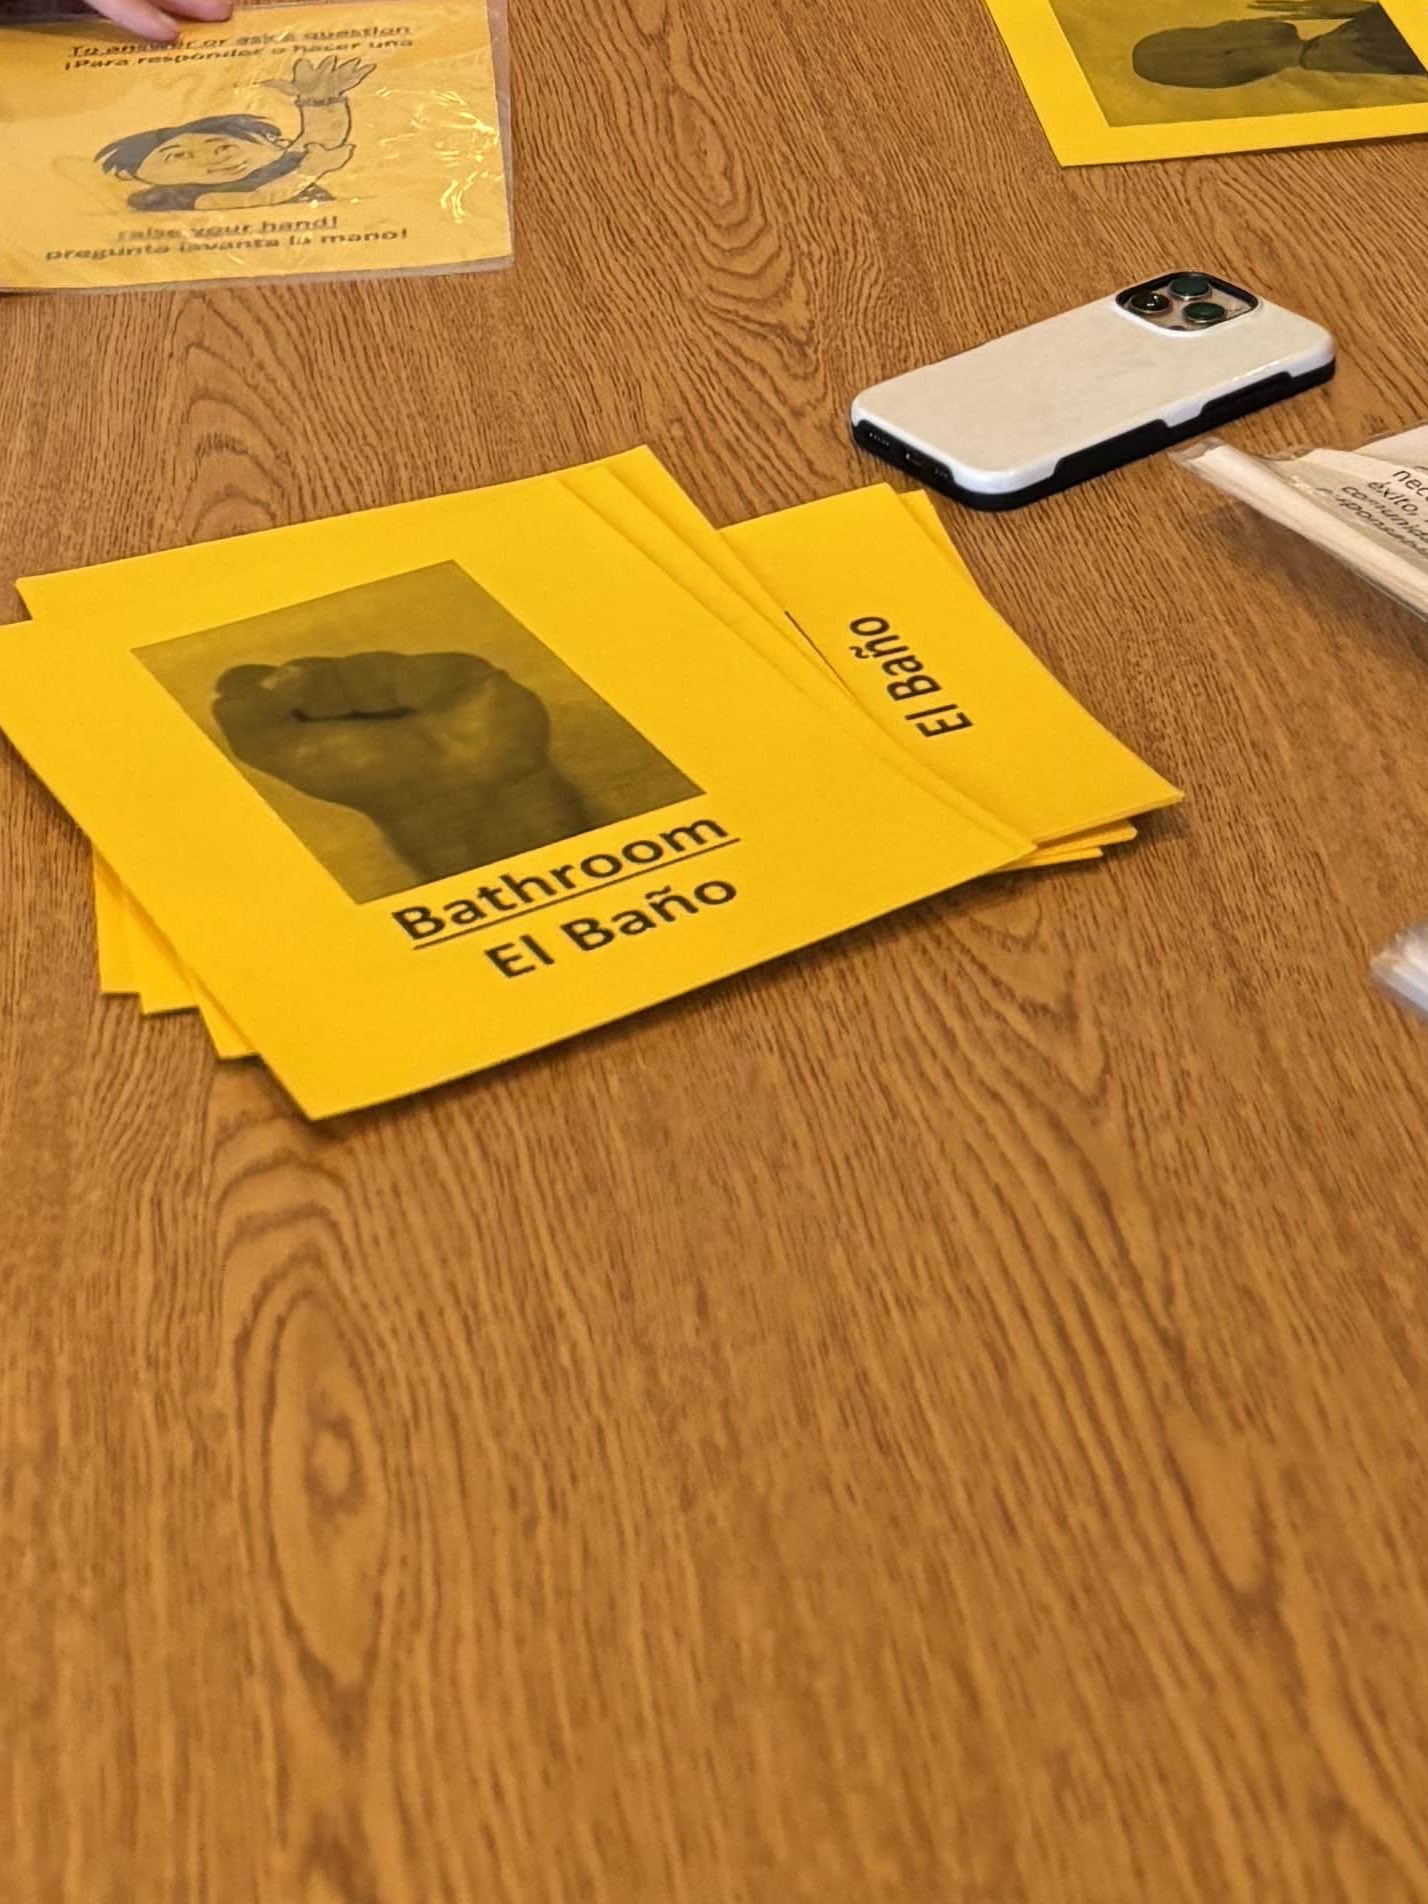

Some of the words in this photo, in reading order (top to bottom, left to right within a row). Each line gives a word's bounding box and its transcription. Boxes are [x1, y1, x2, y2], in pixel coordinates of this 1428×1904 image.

[137, 46, 262, 65] responder
[204, 39, 229, 49] or
[260, 215, 339, 234] hand!
[45, 243, 170, 262] pregunta
[320, 228, 409, 244] mano!
[848, 614, 939, 702] Baño
[903, 702, 974, 740] El
[391, 817, 729, 941] Bathroom
[484, 932, 554, 982] El
[559, 875, 739, 954] Baño
